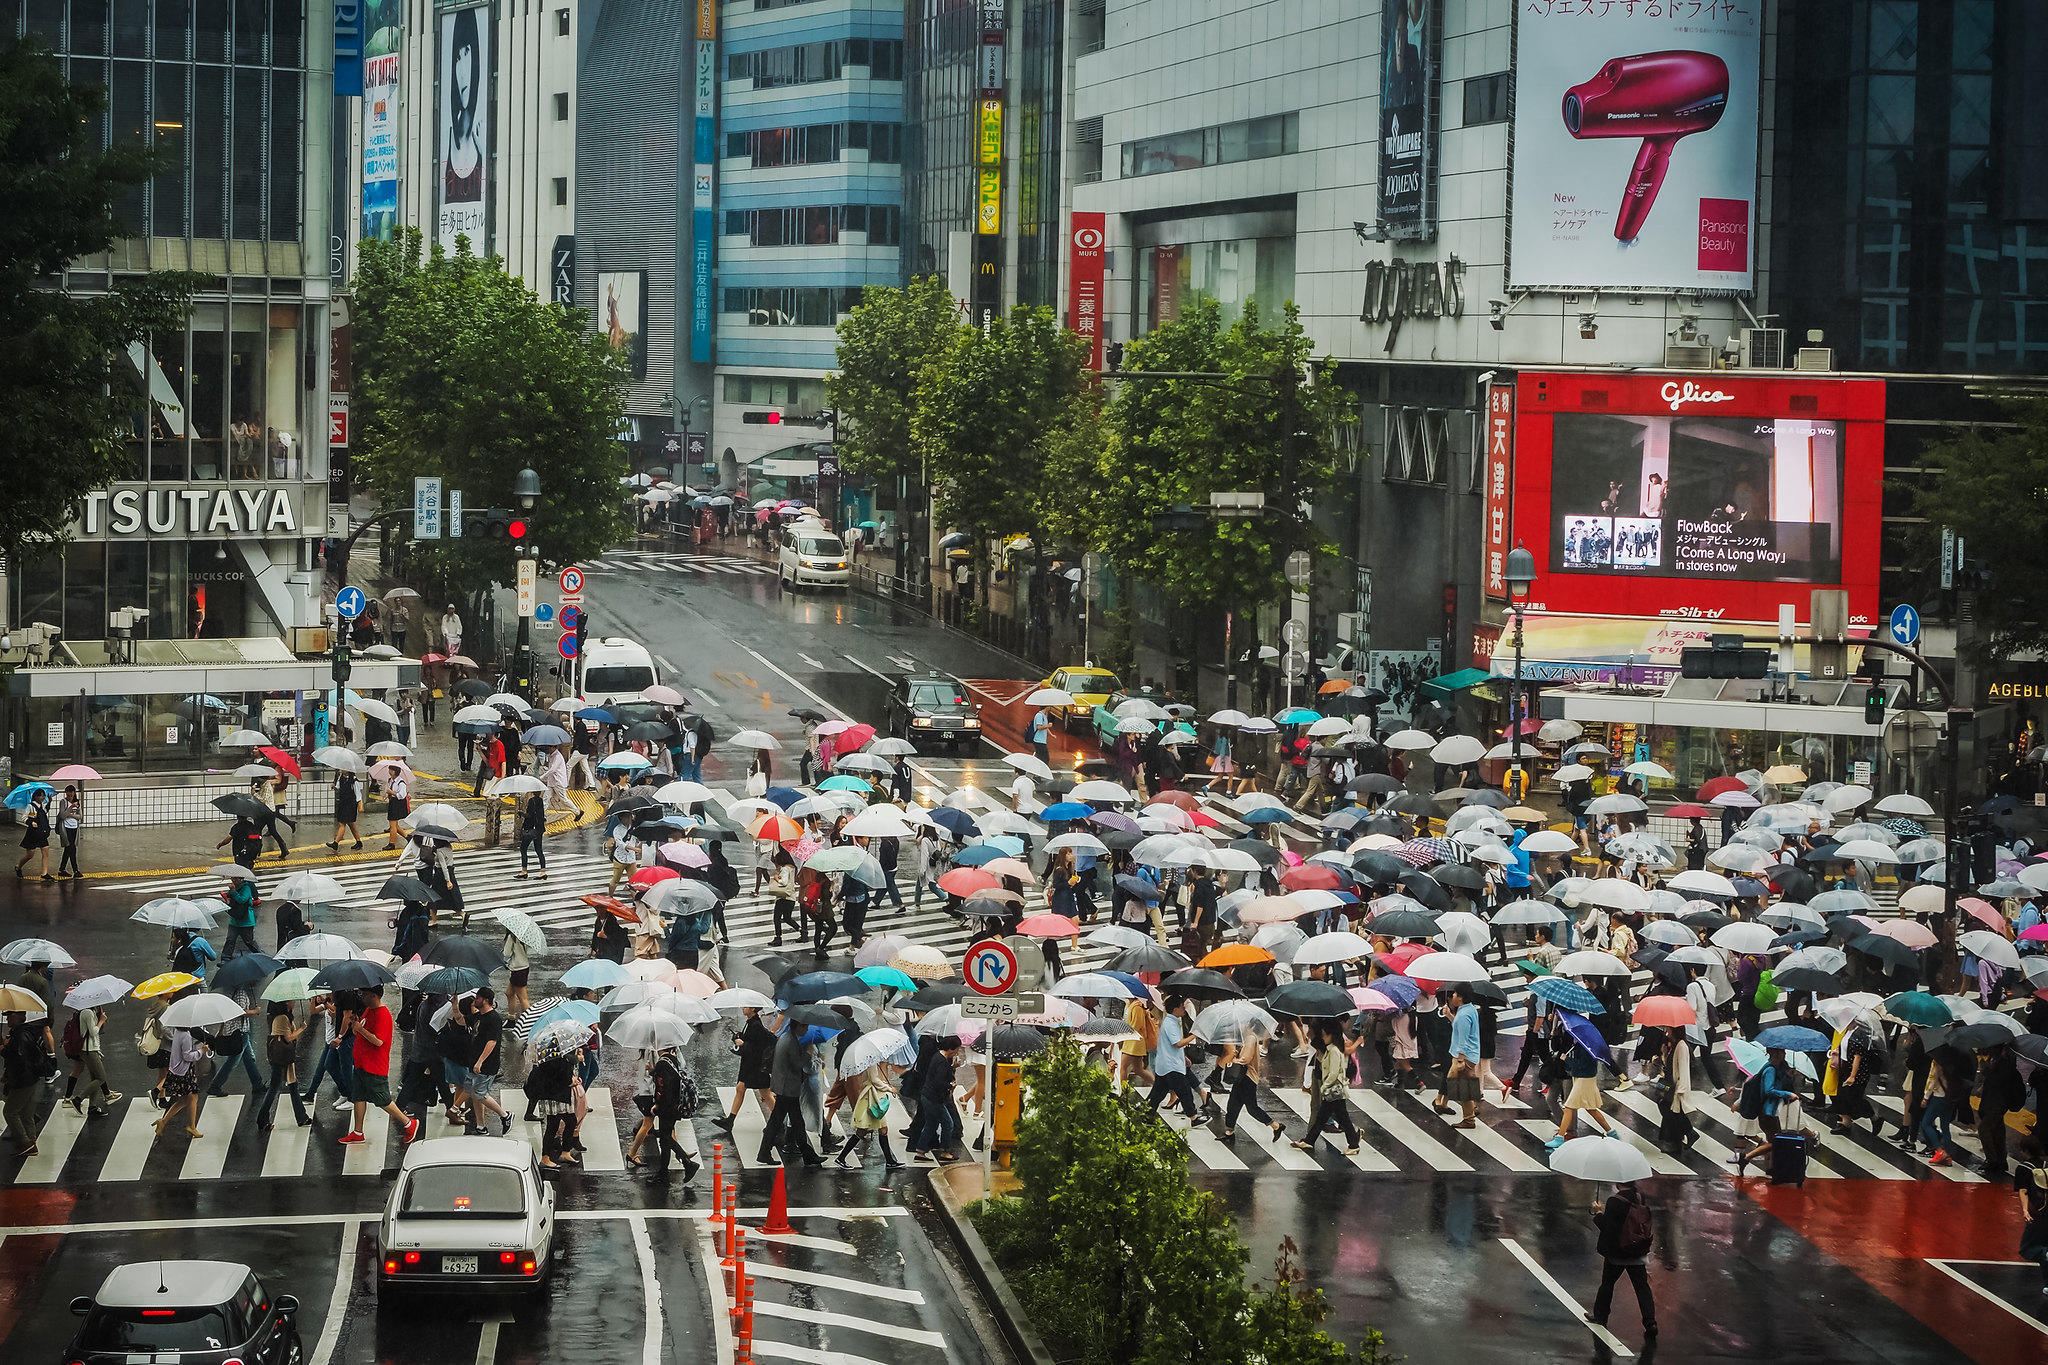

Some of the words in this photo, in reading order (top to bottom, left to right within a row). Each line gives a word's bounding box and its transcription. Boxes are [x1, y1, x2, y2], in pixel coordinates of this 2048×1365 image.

[985, 102, 997, 110] 4F
[1607, 112, 1640, 120] Panasonic
[1553, 192, 1576, 203] New
[440, 208, 485, 235] 宇多田ヒカル
[1553, 219, 1587, 230] ナノケア
[1701, 218, 1746, 235] Panasonic
[1701, 236, 1736, 255] Beauty
[1492, 391, 1510, 413] 名物
[1660, 381, 1735, 411] Glico
[1817, 428, 1836, 437] Way
[425, 482, 437, 534] 渋谷駅前
[1490, 418, 1506, 590] 天津甘栗
[84, 489, 296, 534] TSUTAYA
[1677, 519, 1733, 534] FlowBack
[1676, 534, 1768, 547] メジャーデビューシングル
[1716, 548, 1725, 559] A
[1727, 548, 1755, 562] Long
[1675, 560, 1685, 570] in
[1686, 561, 1714, 572] stores
[1715, 563, 1738, 572] now
[1849, 614, 1868, 624] pdc
[1647, 646, 1682, 655] くすり
[1519, 665, 1600, 682] SANZENRI
[1643, 670, 1682, 686] 三千里
[965, 1002, 1013, 1015] ここから
[450, 1263, 476, 1273] 69-25
